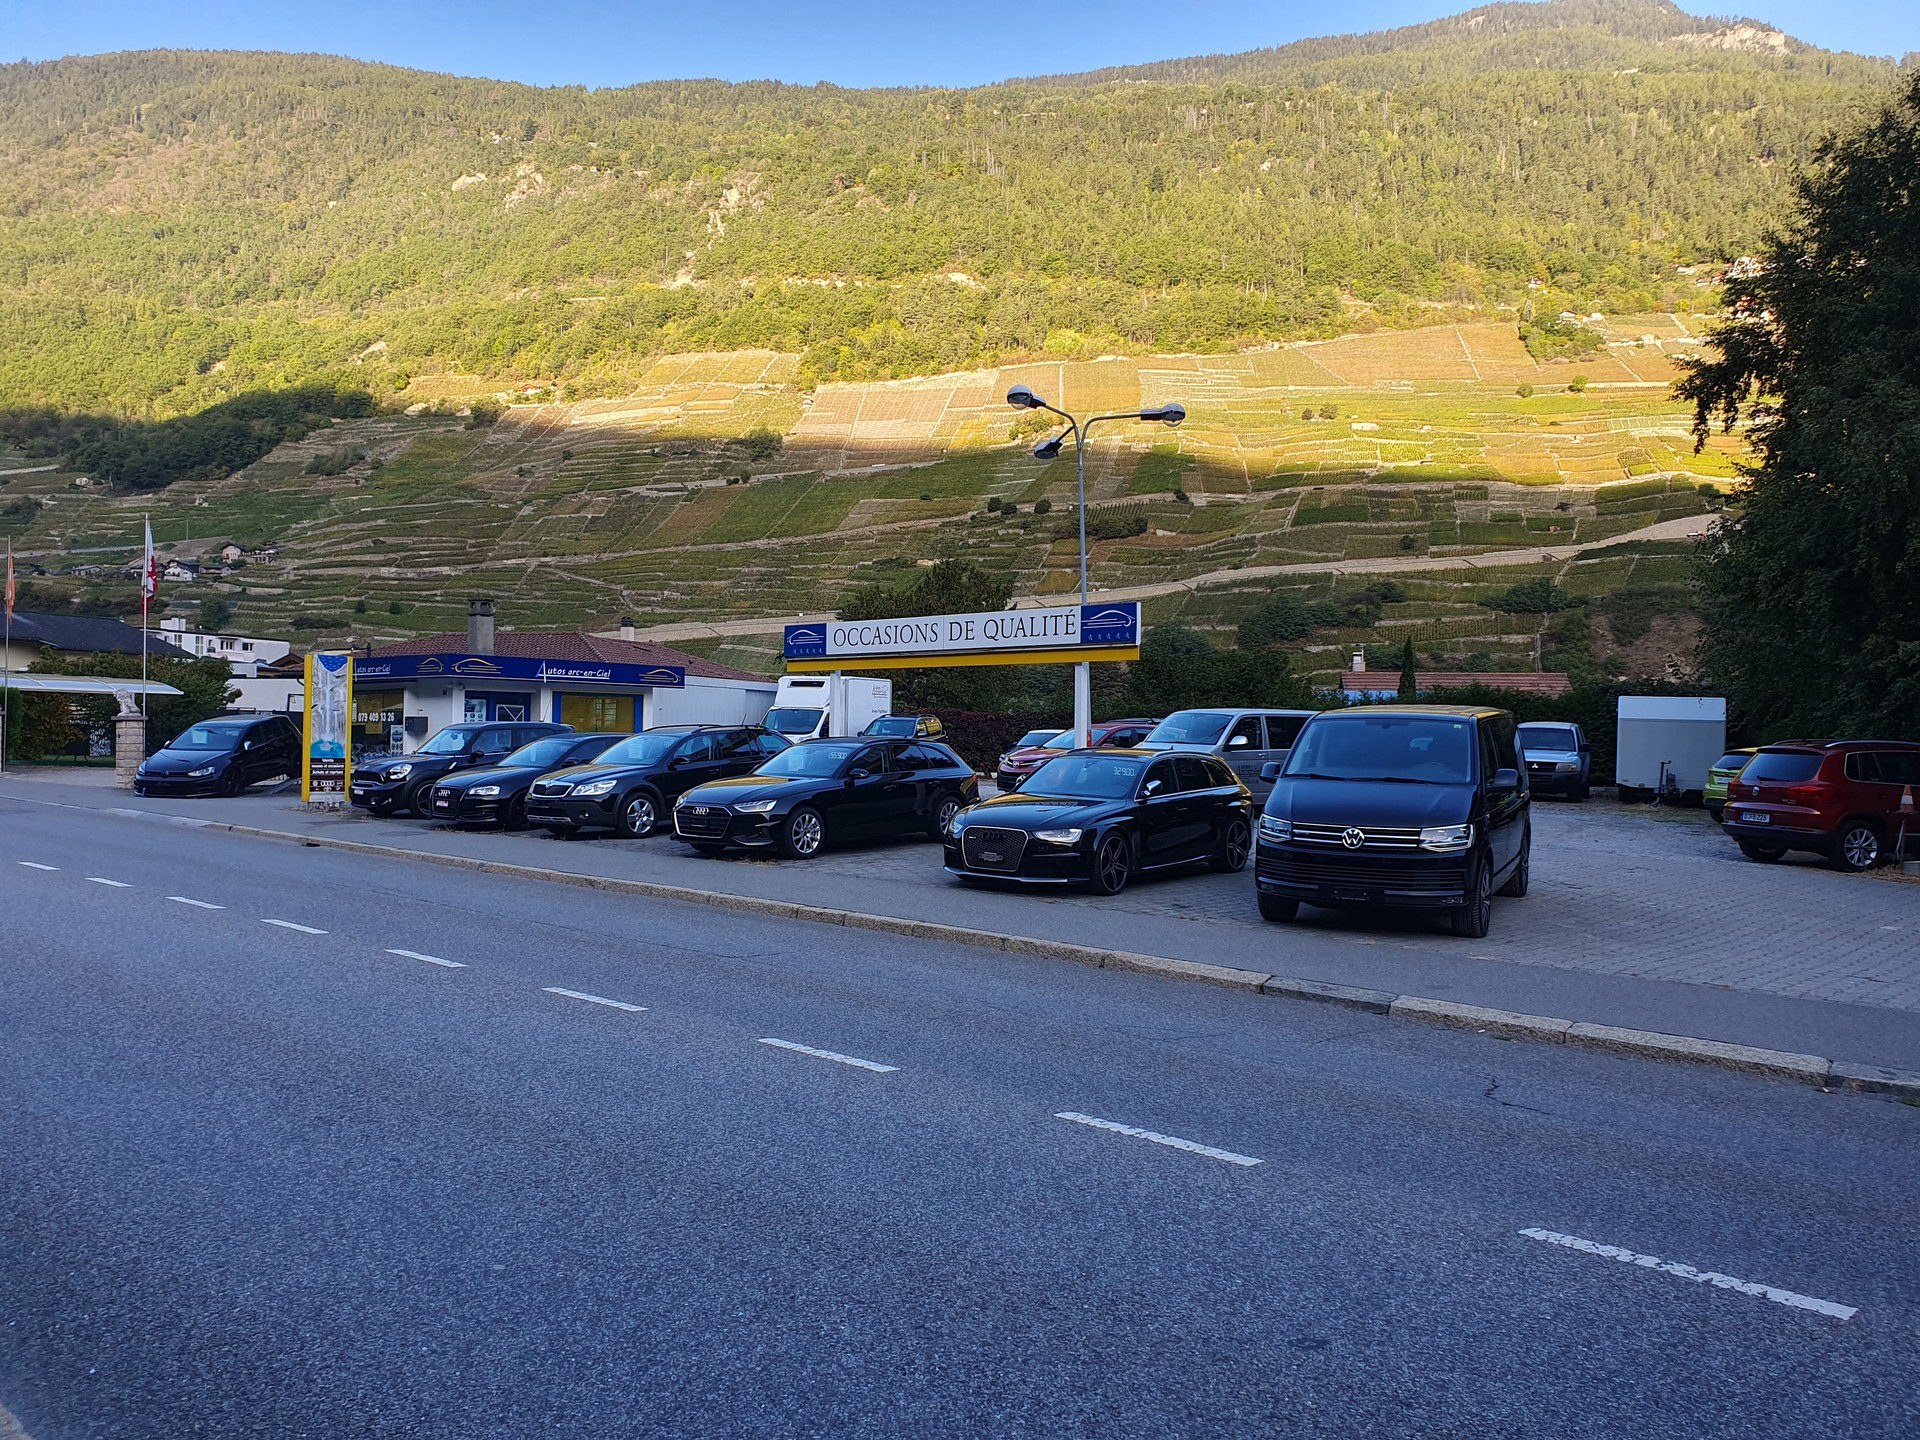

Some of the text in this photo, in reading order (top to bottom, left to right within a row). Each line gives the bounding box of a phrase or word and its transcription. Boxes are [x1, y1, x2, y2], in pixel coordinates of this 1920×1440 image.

[833, 609, 1077, 647] OCCASIONS DE QUALITÉ
[535, 660, 566, 683] Autos
[358, 712, 368, 722] 079
